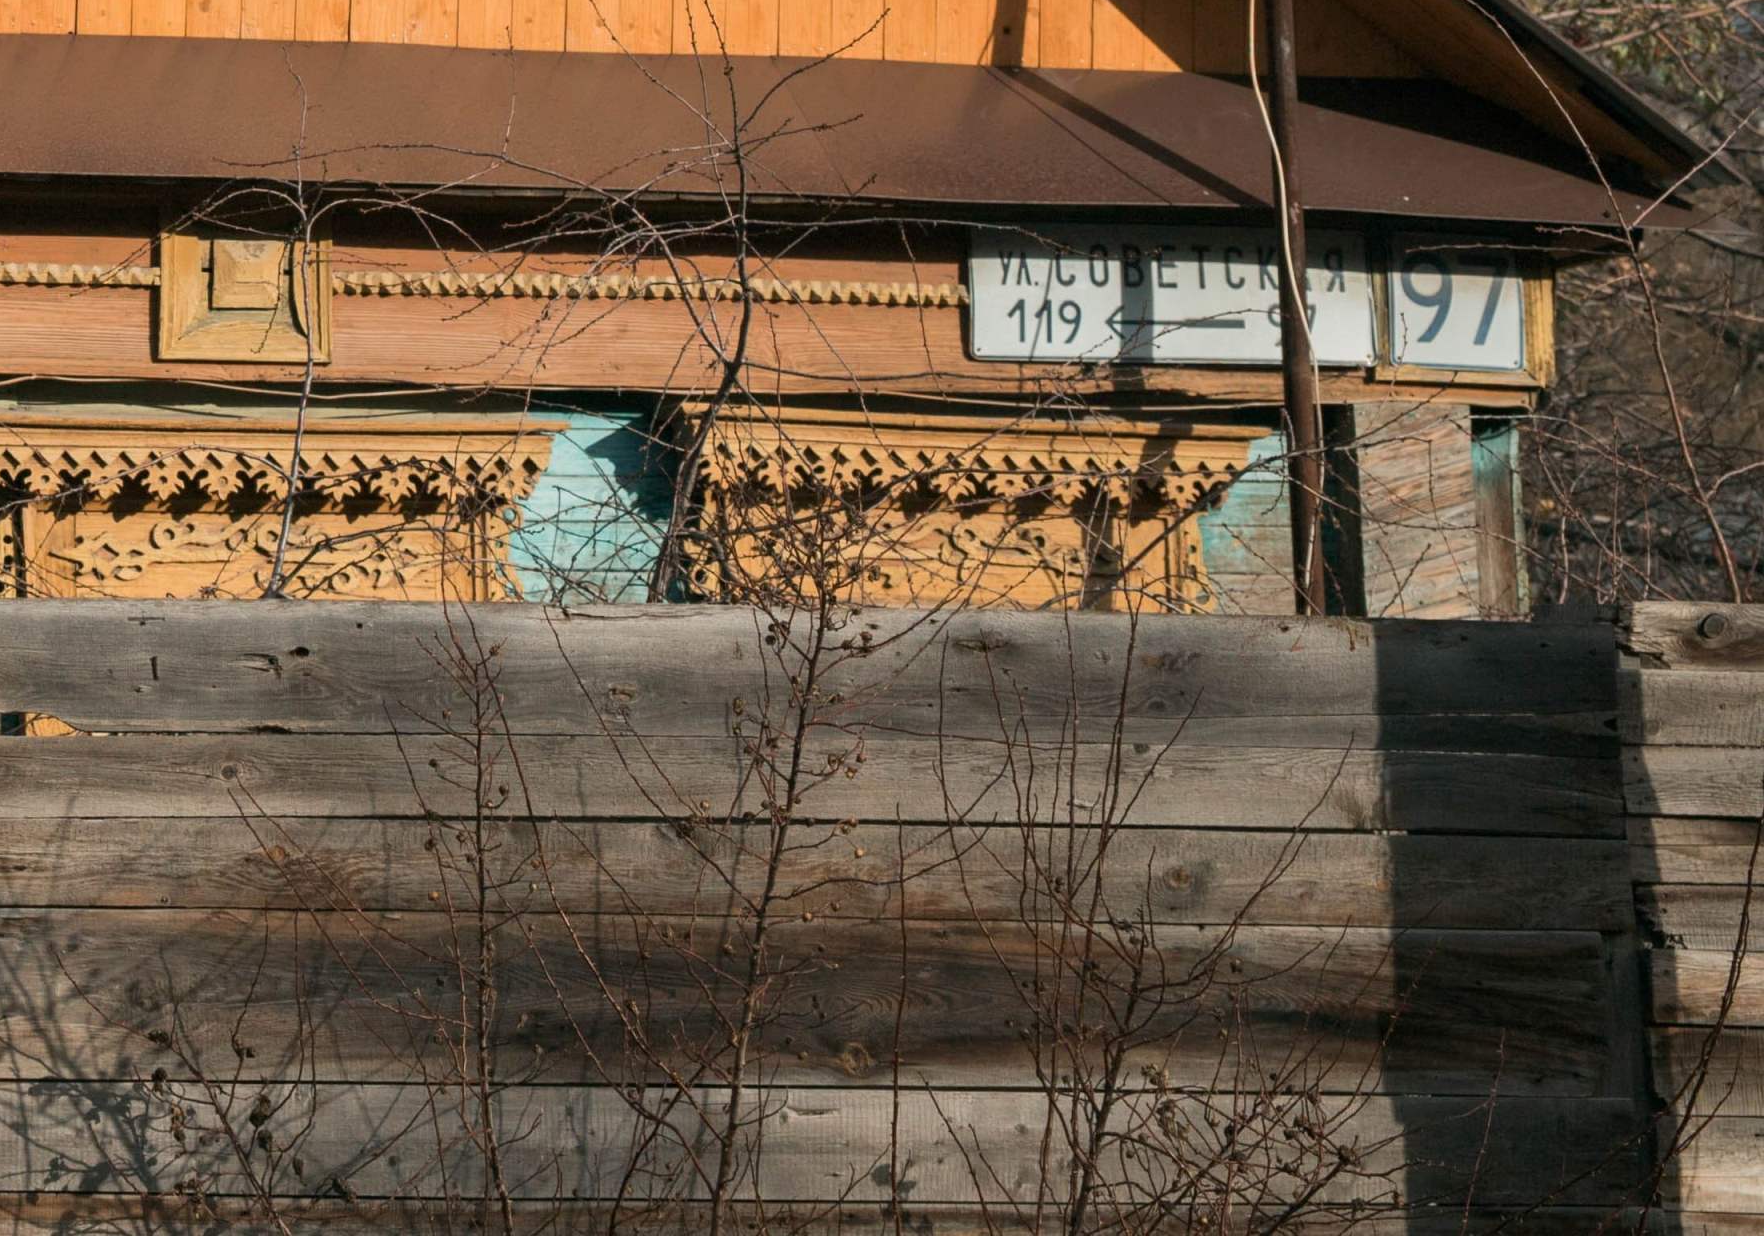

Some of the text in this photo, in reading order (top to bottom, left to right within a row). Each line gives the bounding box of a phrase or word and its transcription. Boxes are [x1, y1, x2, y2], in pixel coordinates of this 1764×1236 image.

[1055, 243, 1345, 293] СОВЕТСКЯ
[1007, 299, 1082, 344] 119
[1401, 253, 1511, 346] 97
